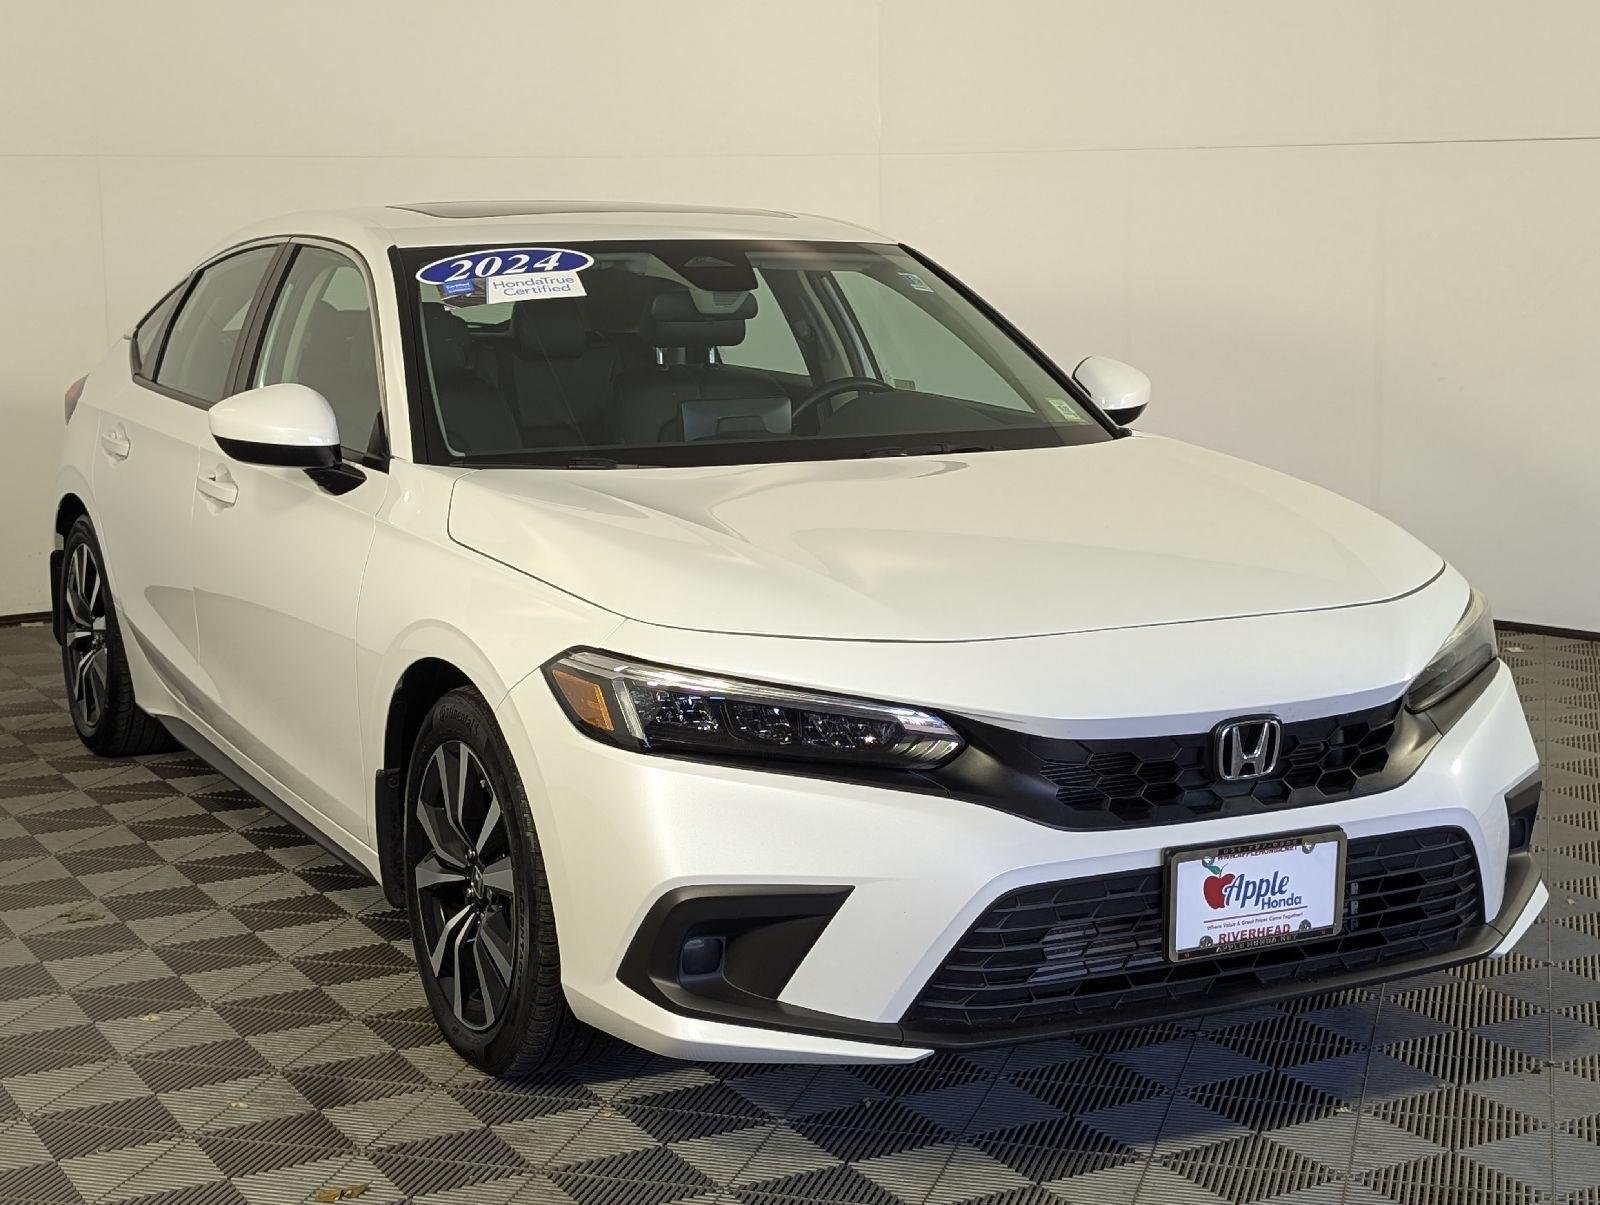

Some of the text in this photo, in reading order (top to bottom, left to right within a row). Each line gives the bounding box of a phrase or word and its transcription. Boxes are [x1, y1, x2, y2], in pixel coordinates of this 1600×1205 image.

[444, 252, 563, 283] 2024
[492, 276, 575, 290] HondaTrue
[503, 284, 571, 297] Certified
[1224, 870, 1290, 909] Apple
[1261, 893, 1302, 910] Honda
[1217, 923, 1291, 945] RIVERHEAD
